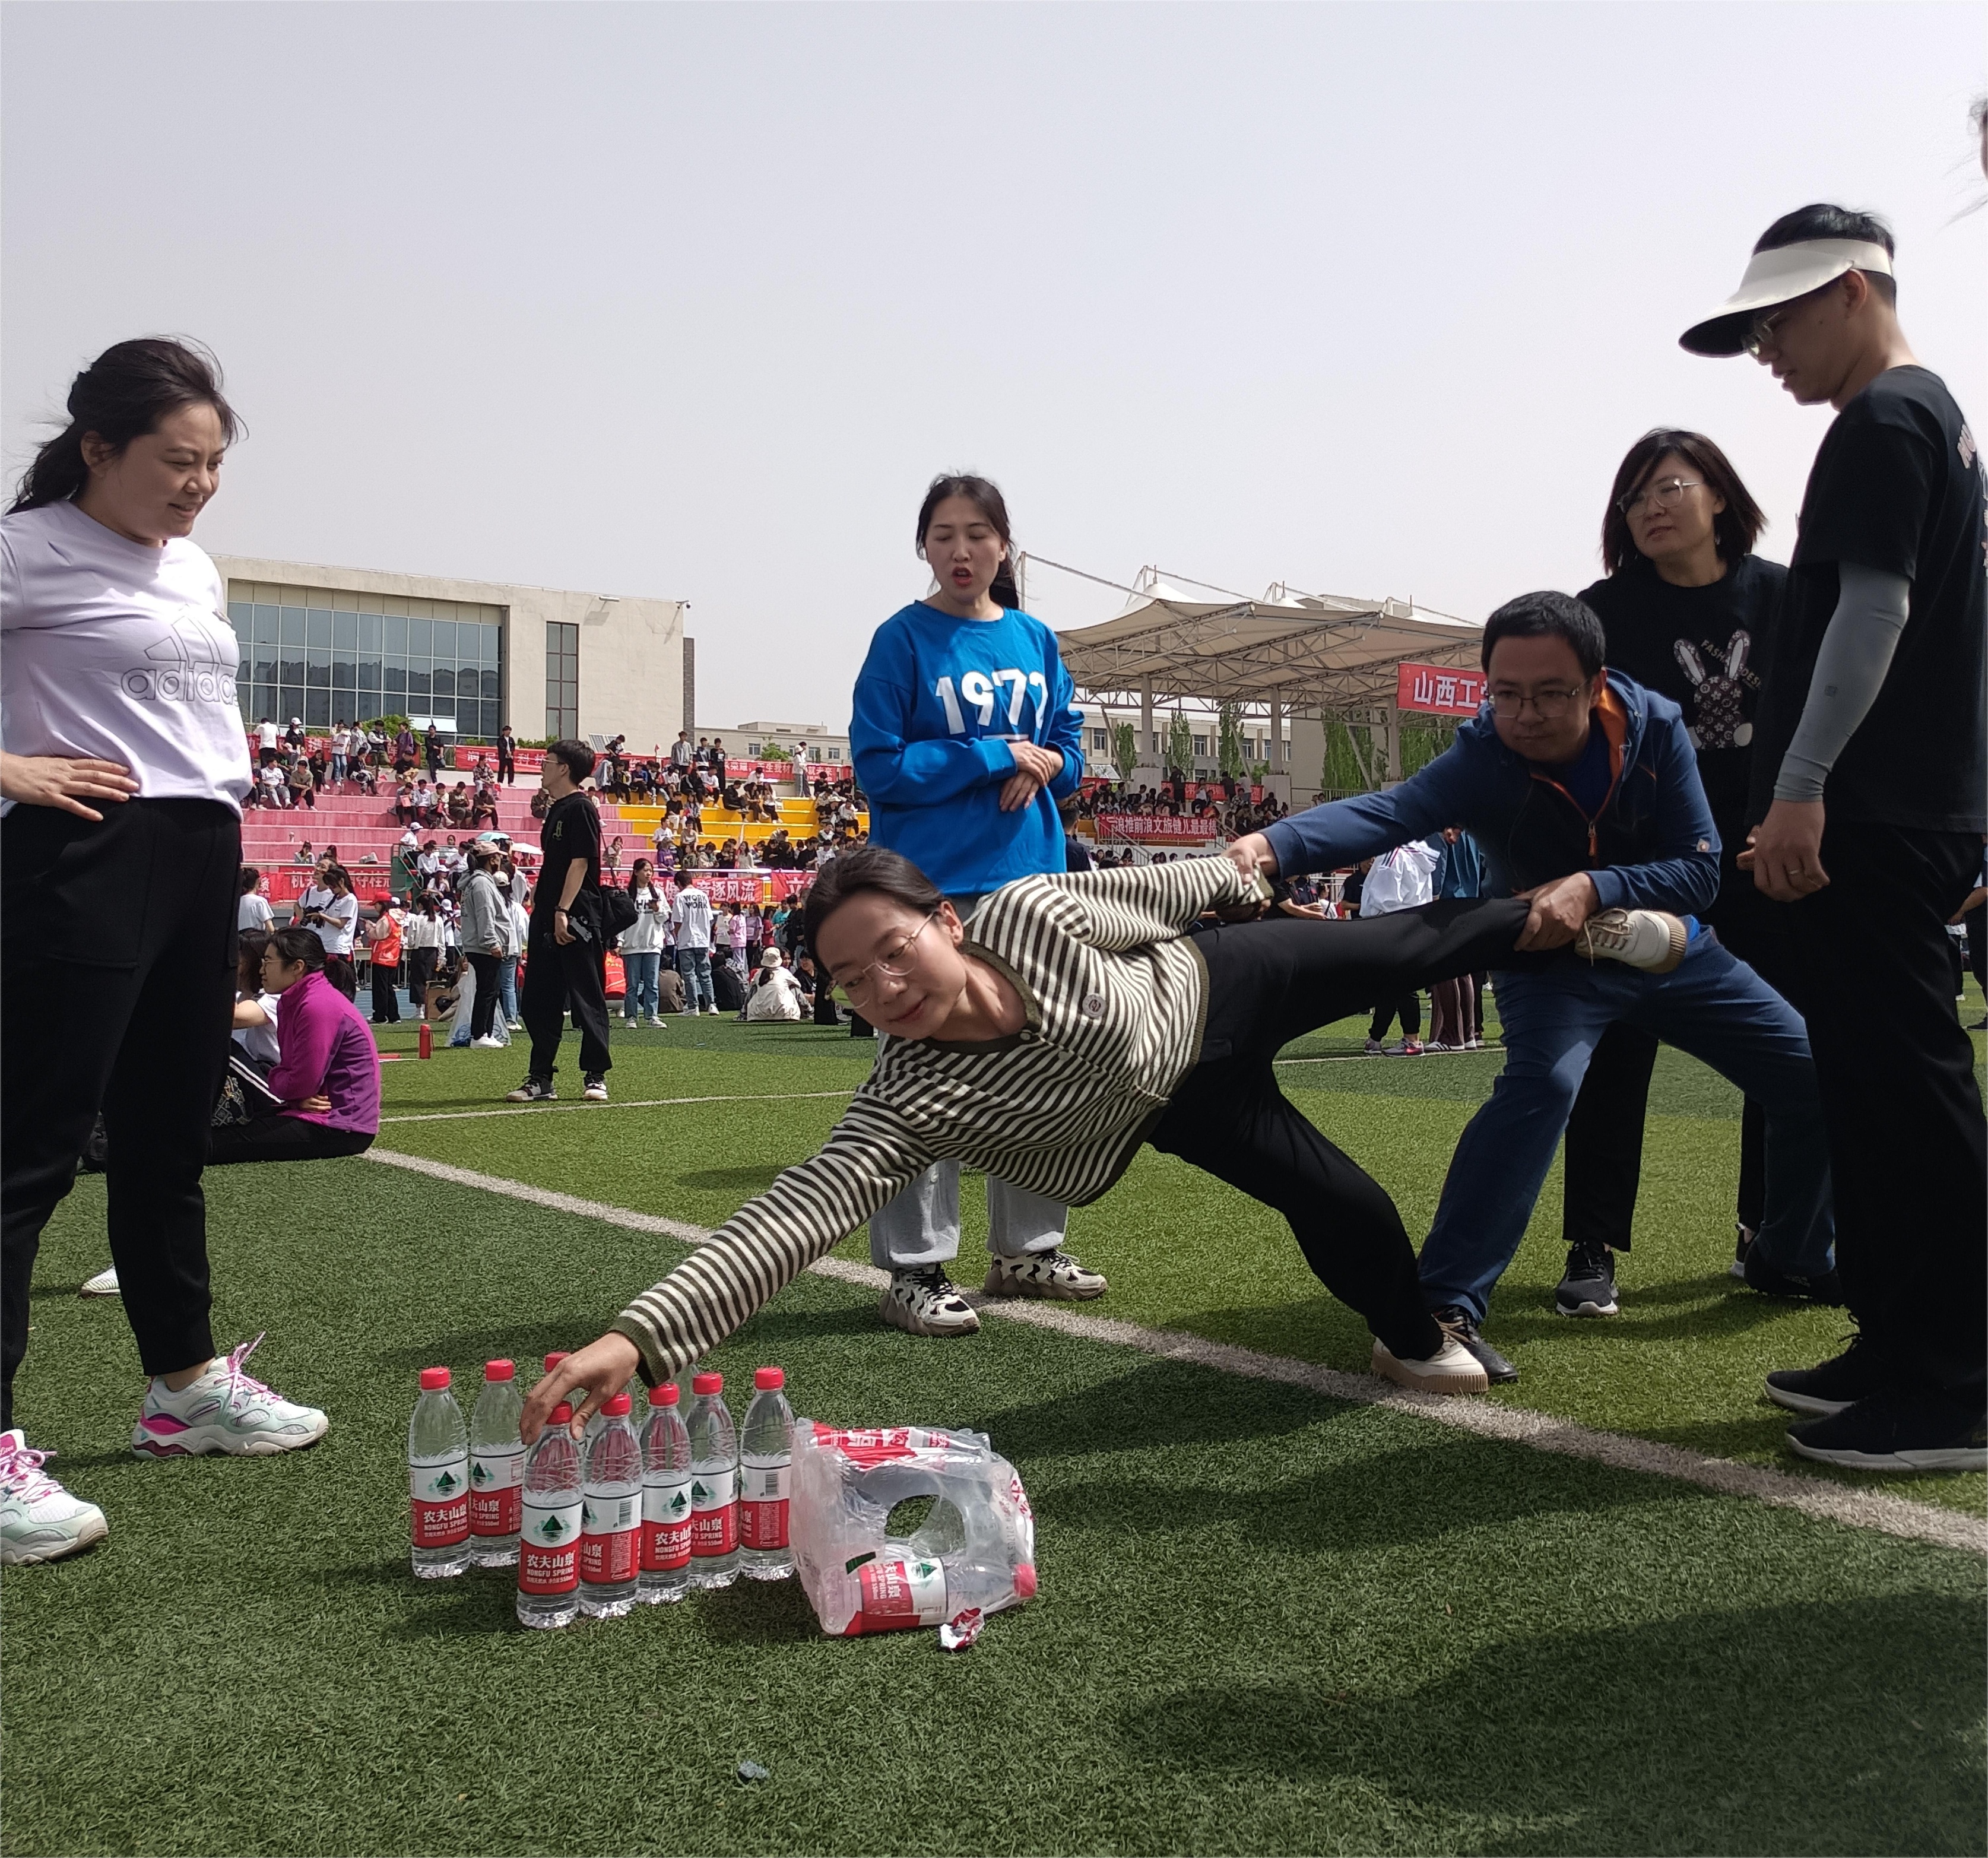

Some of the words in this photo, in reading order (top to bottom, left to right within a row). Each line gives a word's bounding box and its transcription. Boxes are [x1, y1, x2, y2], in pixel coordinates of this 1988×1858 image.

[423, 1502, 467, 1523] 农夫山泉
[471, 1498, 500, 1513] 夫山泉
[424, 1523, 448, 1531] NONGFU
[690, 1517, 723, 1532] 夫山泉
[655, 1524, 691, 1545] 农夫山
[700, 1532, 723, 1540] SPRING
[655, 1545, 679, 1554] NONGFU
[527, 1551, 575, 1569] 农夫山泉
[527, 1568, 550, 1577] NONGFU
[553, 1565, 574, 1577] SPRING
[877, 1575, 887, 1599] SPRING
[883, 1562, 902, 1598] 夫山泉
